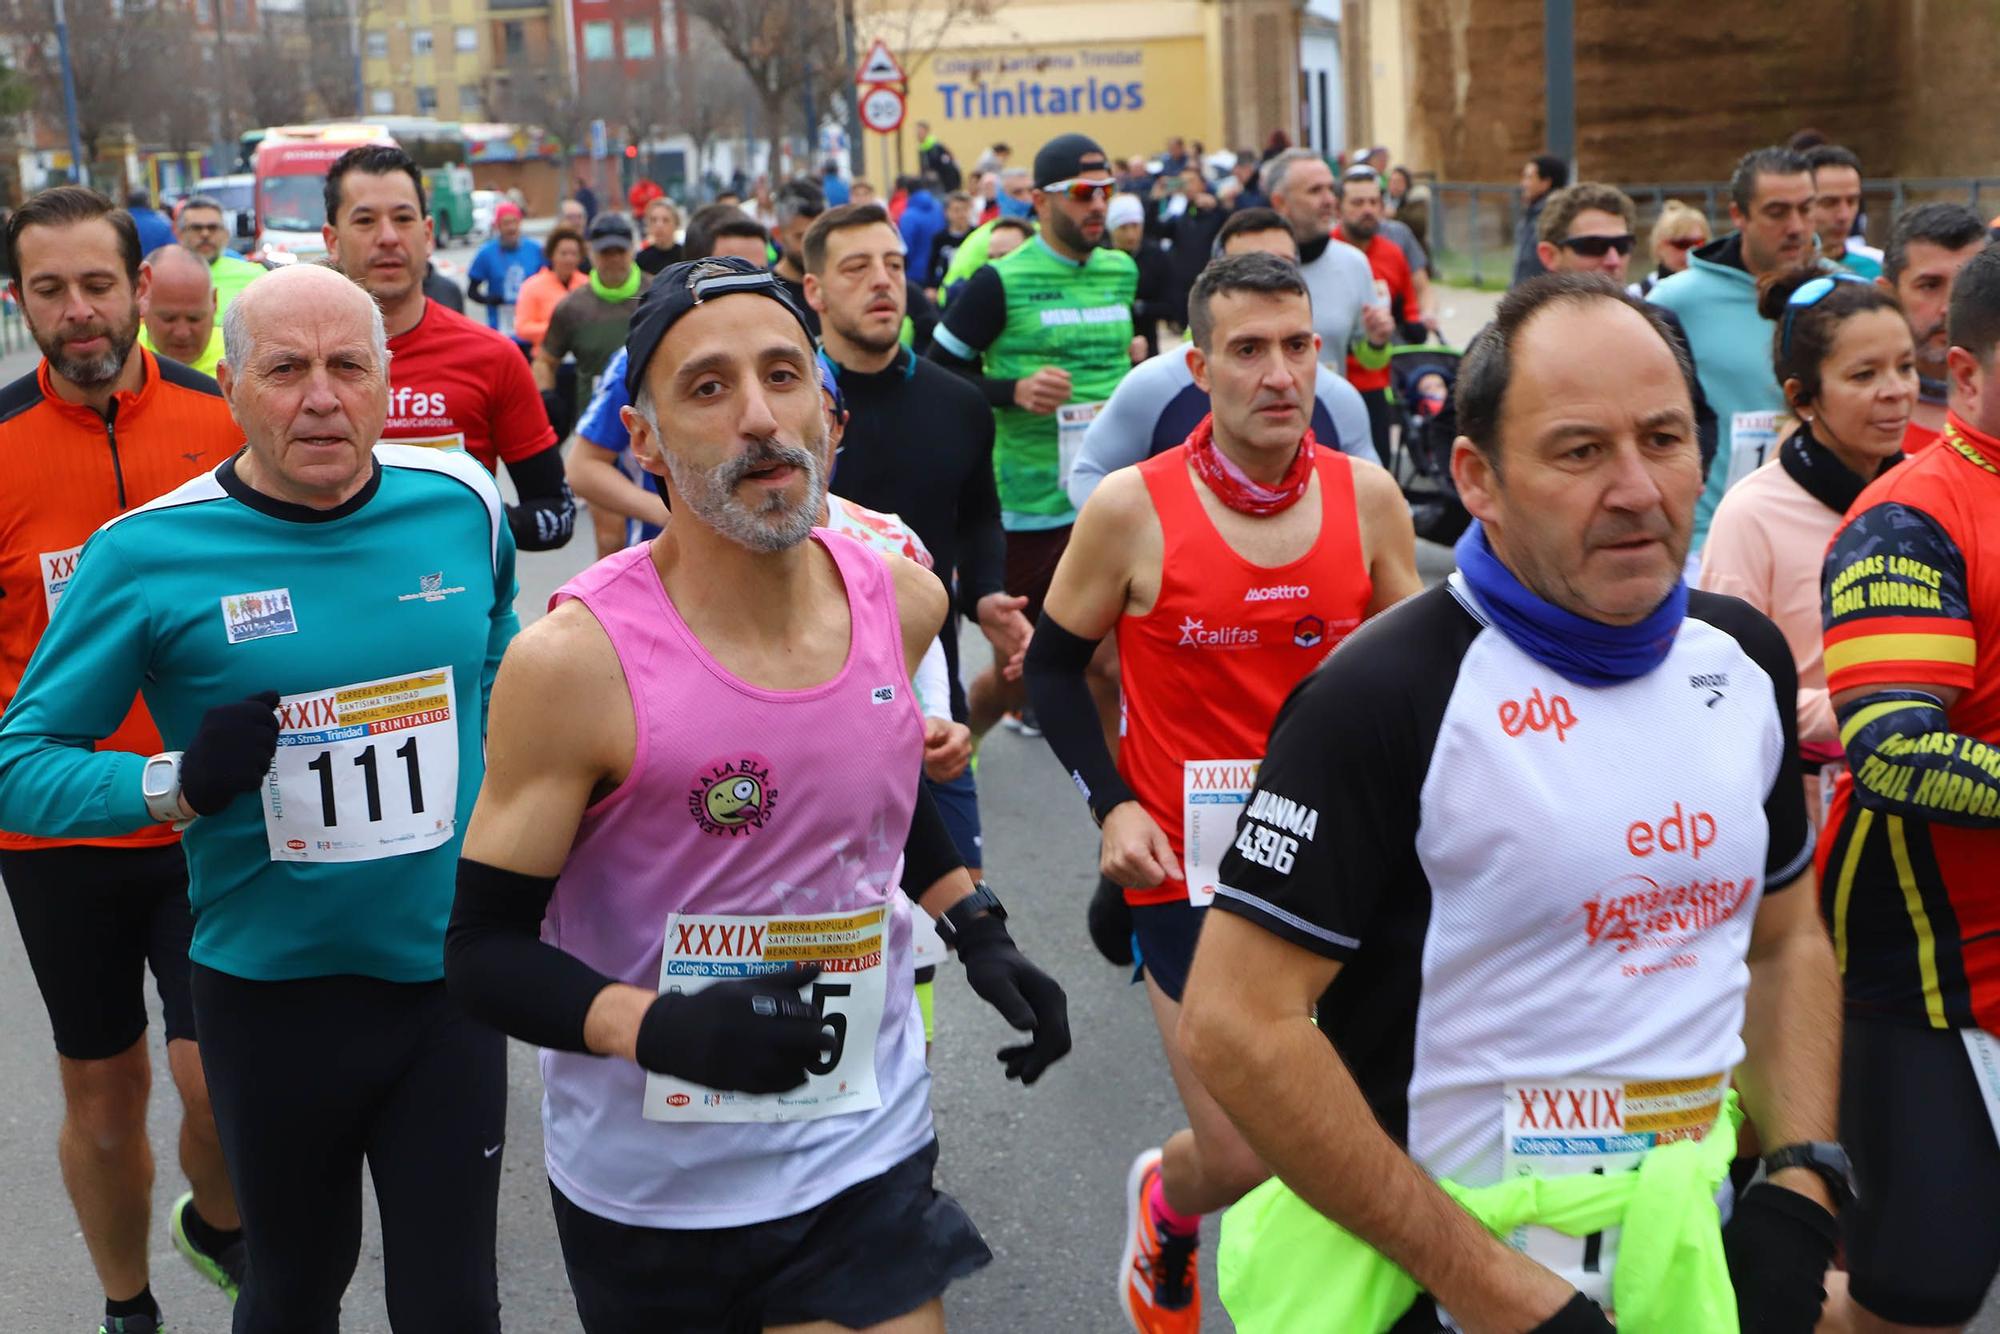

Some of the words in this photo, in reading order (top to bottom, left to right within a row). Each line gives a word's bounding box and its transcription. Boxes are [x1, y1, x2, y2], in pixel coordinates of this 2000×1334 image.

[937, 76, 1144, 119] Trinitarios
[387, 387, 447, 417] ifas
[1888, 555, 1943, 589] LOKAS
[1832, 585, 1866, 618] TRAIL
[1196, 627, 1259, 645] califas
[279, 696, 338, 730] XXIX
[383, 690, 420, 704] TRINIDAD
[327, 726, 364, 741] Trinidad
[371, 709, 450, 733] TRINITARIOS
[1497, 687, 1579, 744] edp
[712, 762, 735, 779] LA
[1959, 738, 2000, 780] LOK
[308, 736, 425, 828] 111
[1192, 766, 1252, 789] XXXIX
[1857, 753, 1916, 802] TRAIL
[1626, 800, 1718, 860] edp
[1235, 822, 1300, 876] 4396
[674, 923, 766, 957] XXXIX
[769, 922, 811, 933] CARRERA
[814, 919, 854, 931] POPULAR
[669, 961, 705, 976] Colegio
[707, 962, 742, 976] Stma.
[745, 962, 788, 975] Trinidad
[798, 951, 882, 973] TNITARIOS
[1517, 1087, 1624, 1130] XXXIX
